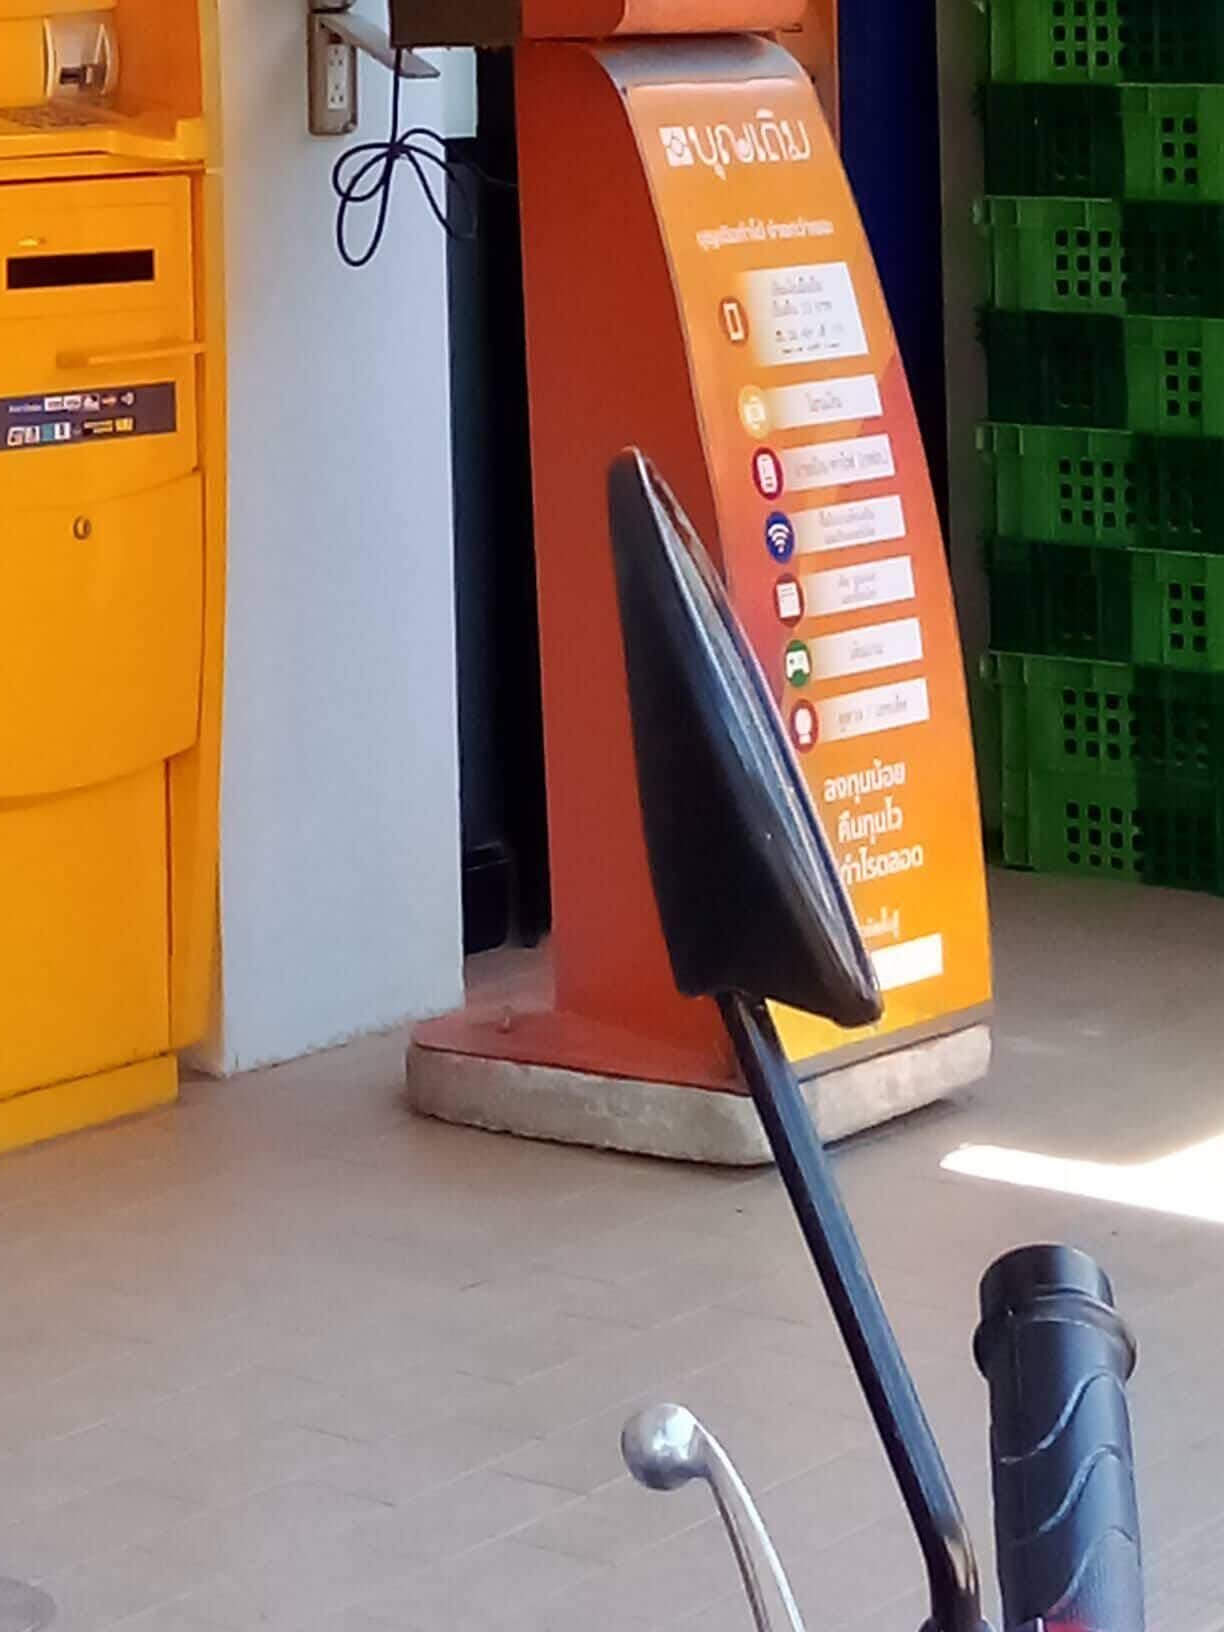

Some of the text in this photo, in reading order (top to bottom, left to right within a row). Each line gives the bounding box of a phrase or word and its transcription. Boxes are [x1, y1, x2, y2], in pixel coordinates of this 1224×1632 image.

[687, 107, 812, 182] บุญเติม
[823, 758, 907, 805] ลงทุนน้อย
